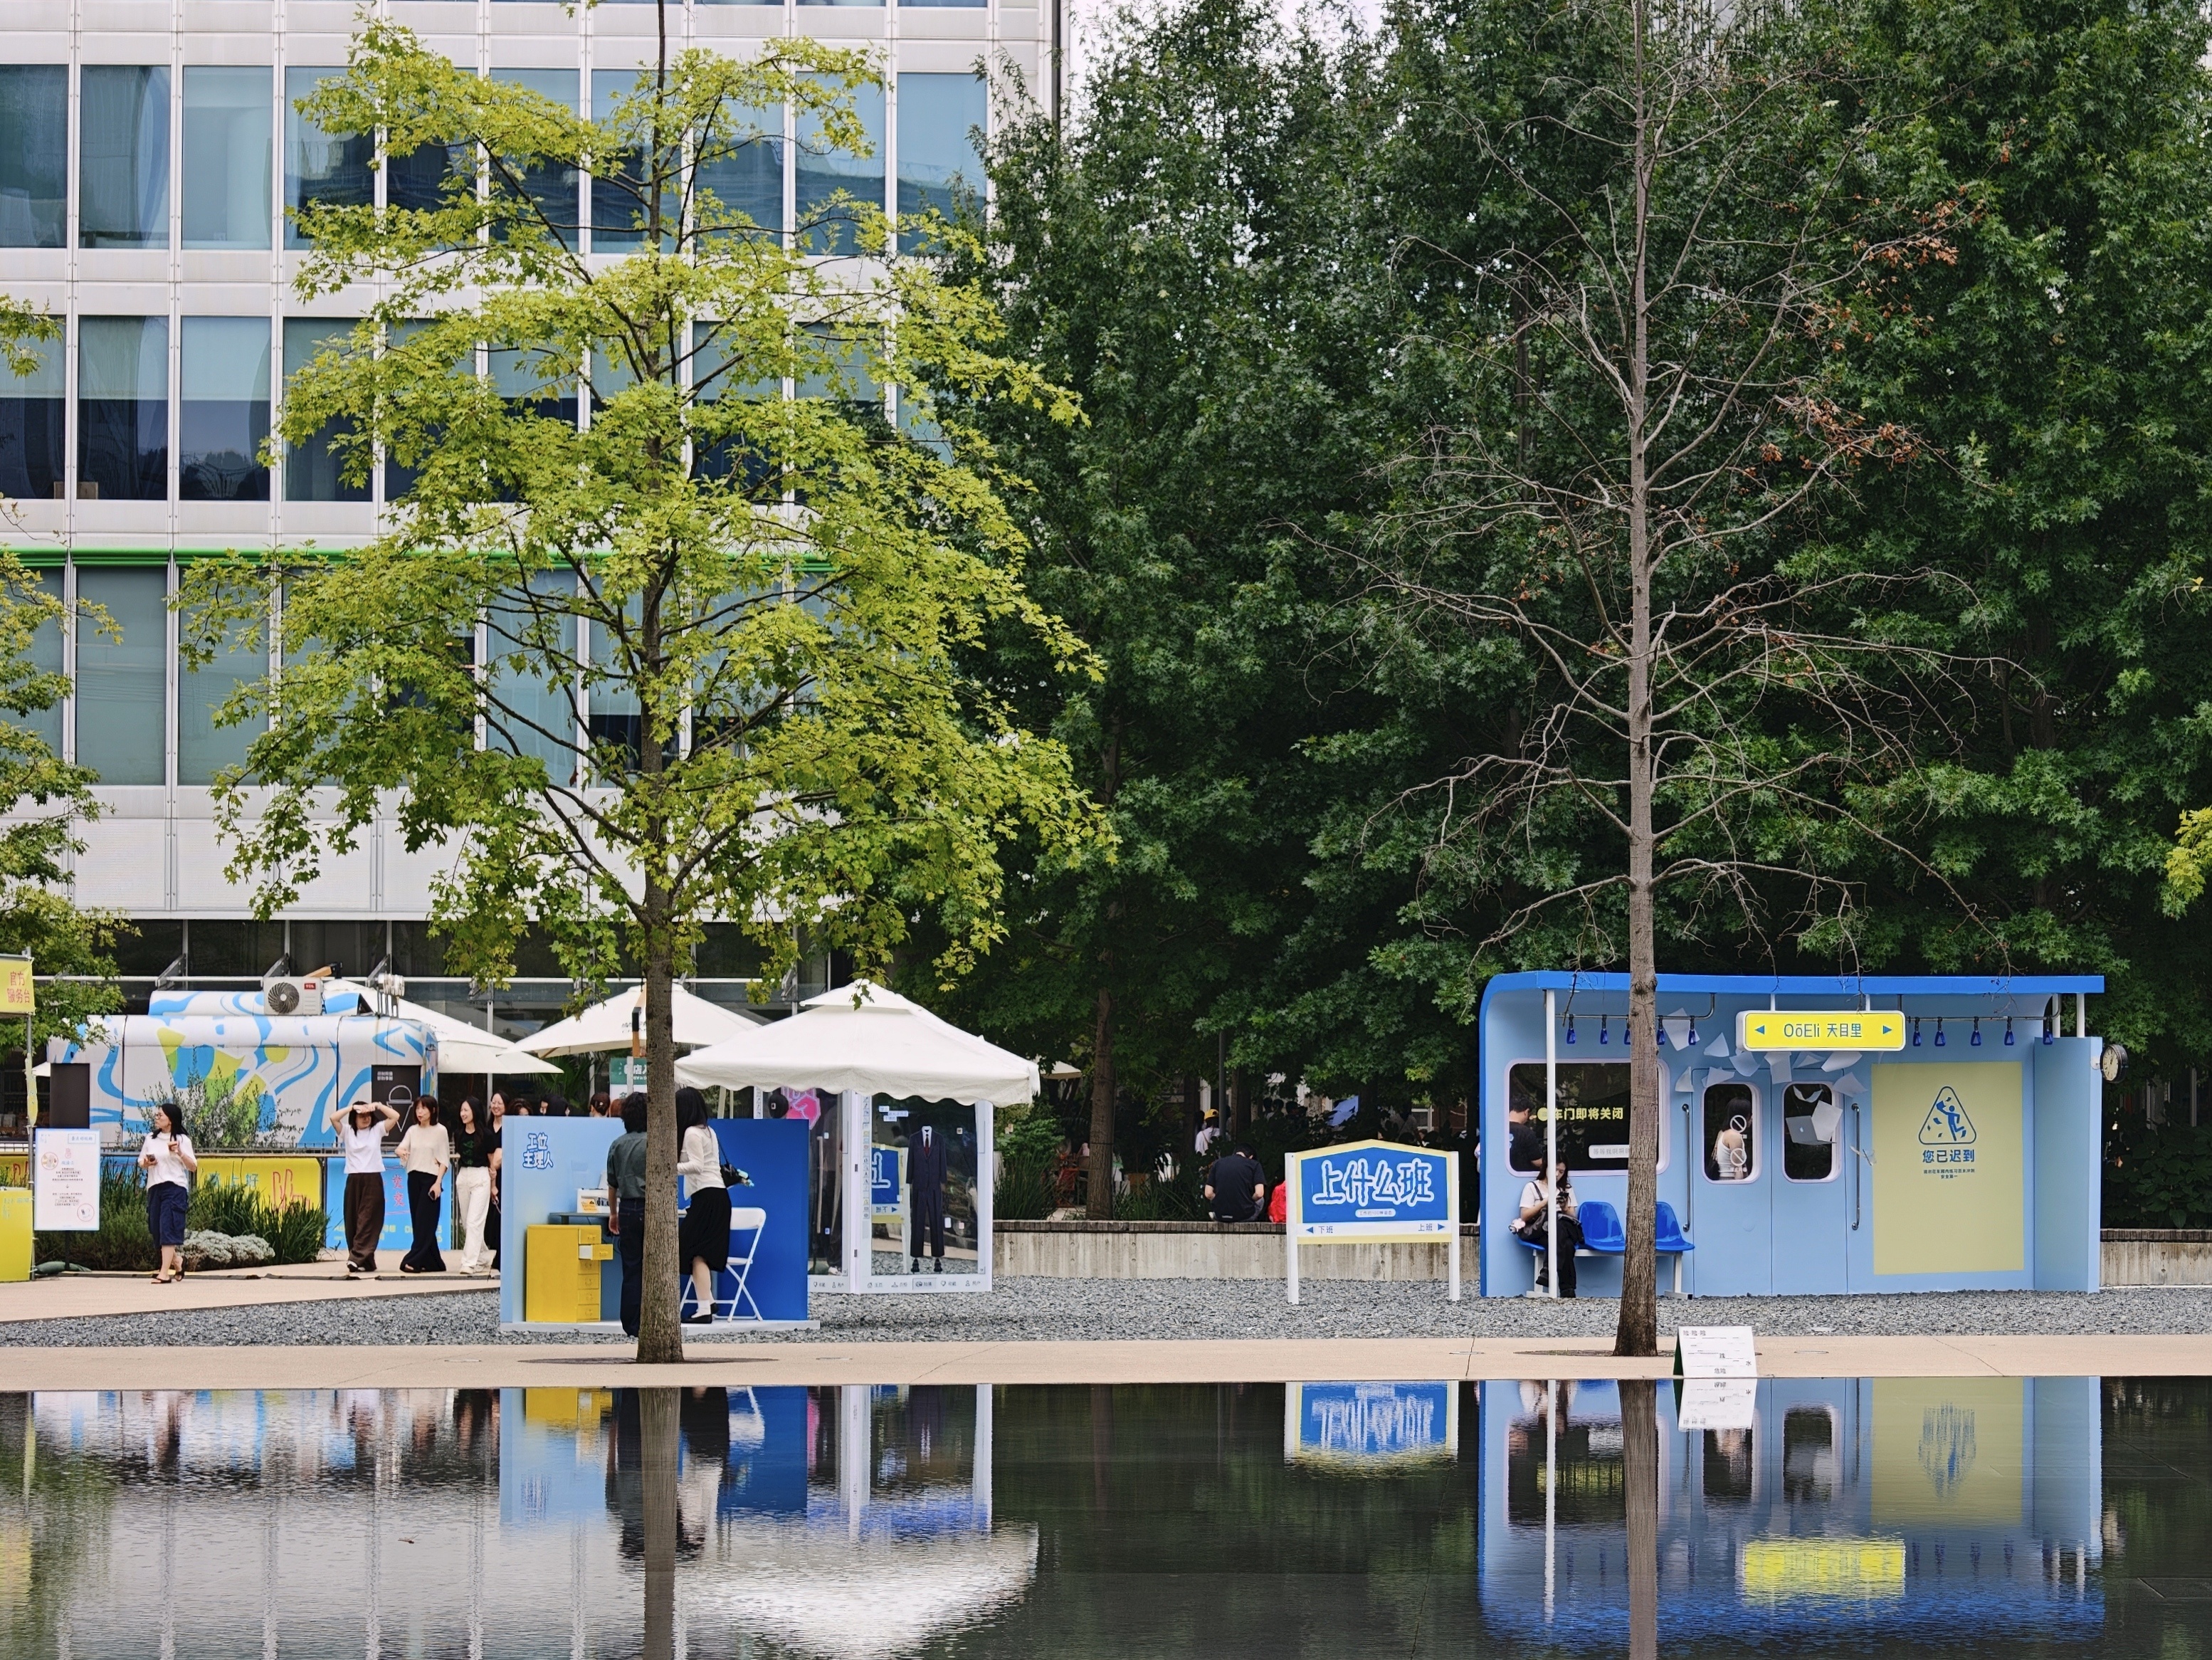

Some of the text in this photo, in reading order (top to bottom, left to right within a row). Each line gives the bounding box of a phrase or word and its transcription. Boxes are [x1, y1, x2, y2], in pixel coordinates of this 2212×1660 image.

[10, 971, 26, 986] 官方
[6, 988, 30, 1004] 服务台
[1784, 1023, 1862, 1038] OōEli 天目里
[1554, 1107, 1623, 1121] 车门即将关闭
[527, 1132, 549, 1151] 工位
[522, 1150, 554, 1170] 主理人
[1922, 1149, 1975, 1164] 您已迟到
[1312, 1157, 1435, 1207] 上什么班
[1318, 1225, 1334, 1234] 下班
[1418, 1223, 1433, 1231] 上班
